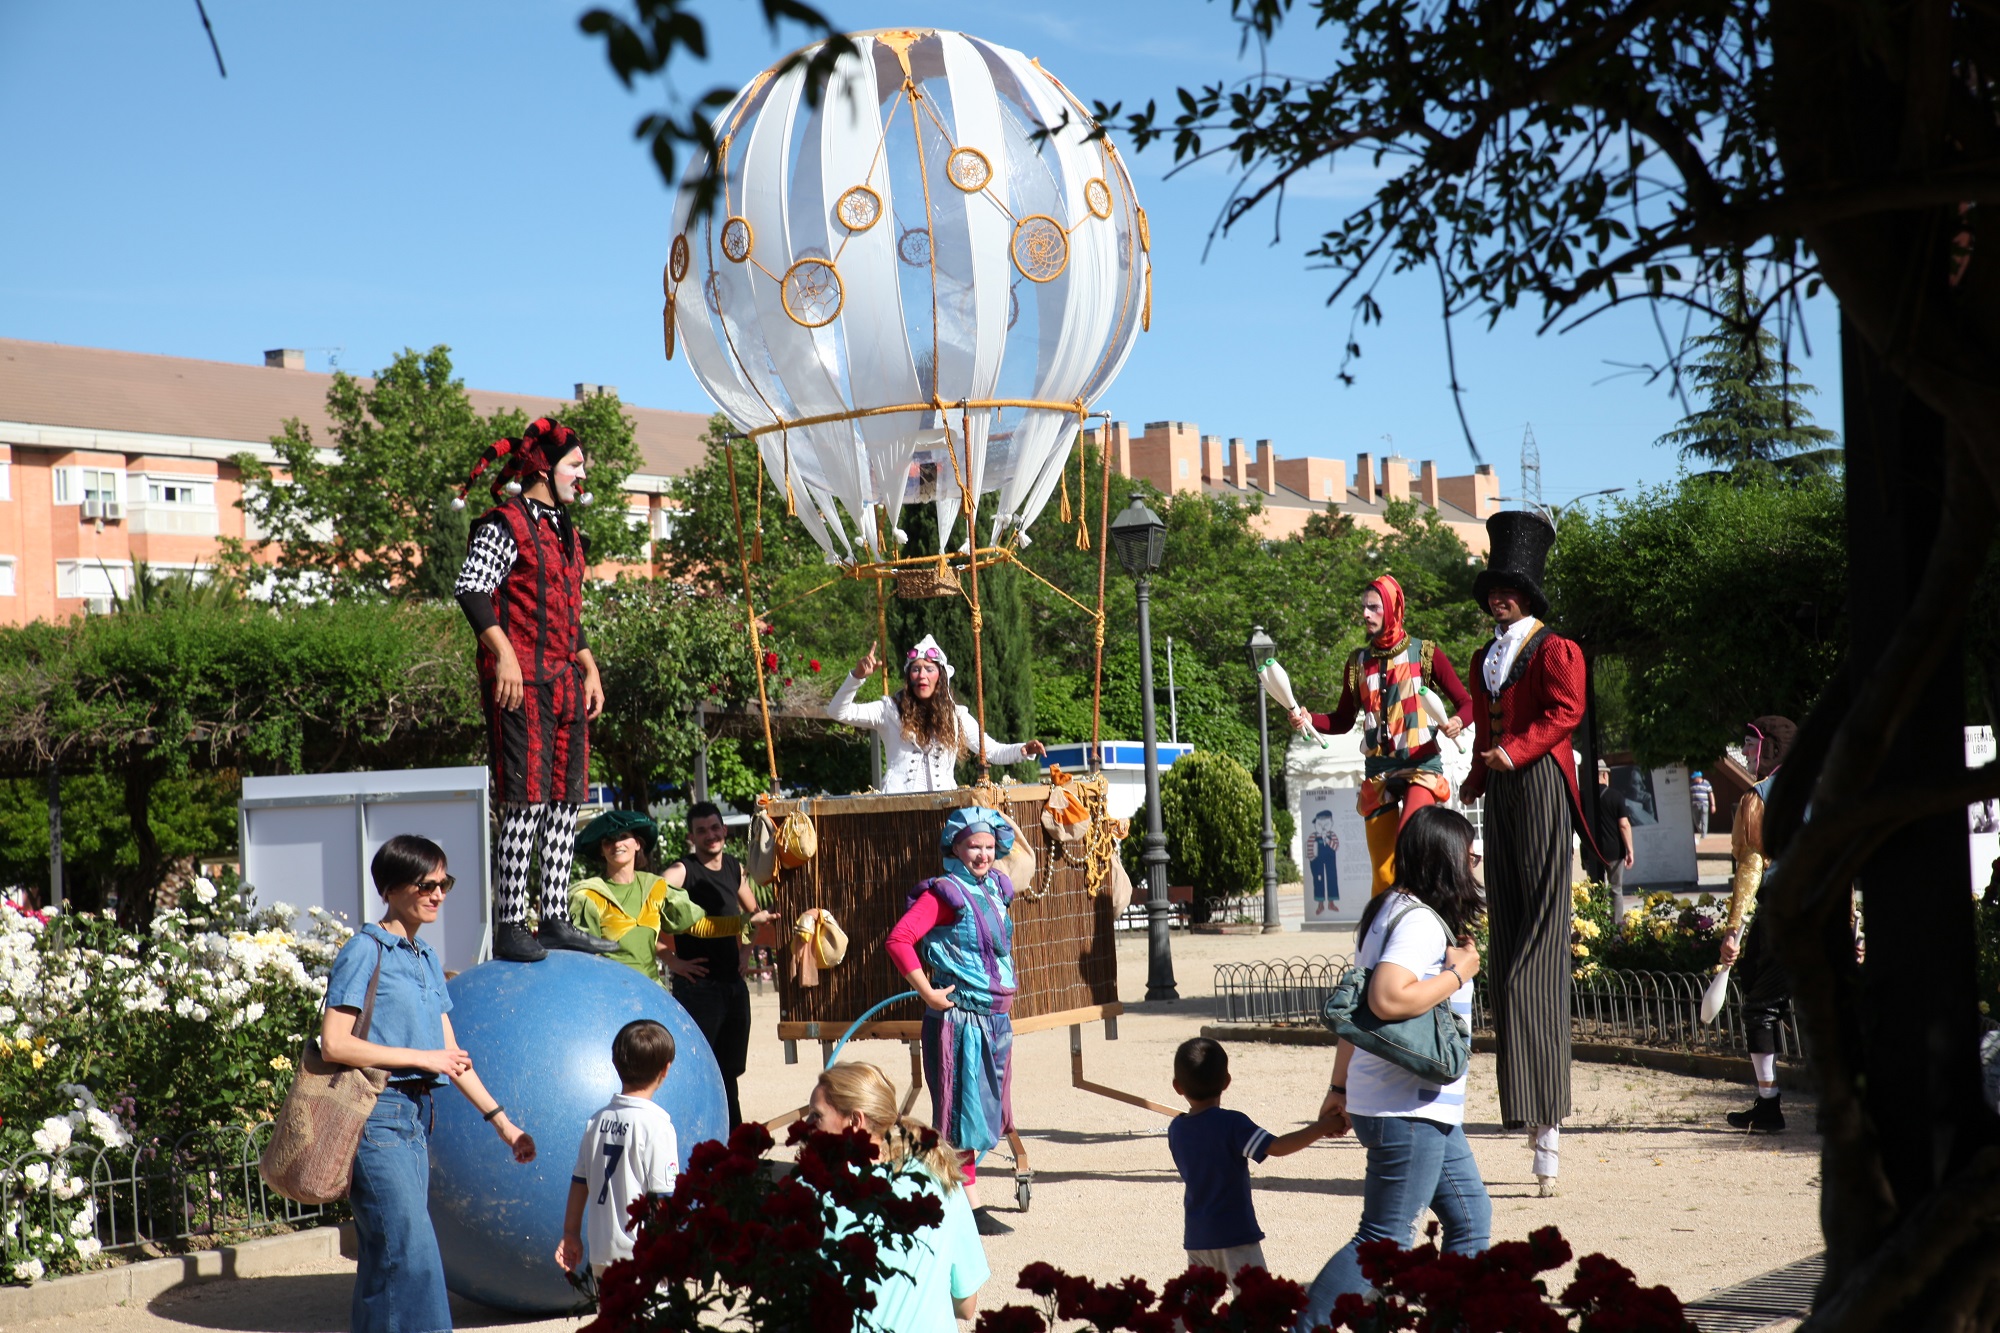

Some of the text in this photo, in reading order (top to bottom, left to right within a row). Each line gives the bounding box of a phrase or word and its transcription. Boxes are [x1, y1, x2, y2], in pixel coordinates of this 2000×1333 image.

[1972, 744, 1988, 754] LIBRO
[600, 1118, 629, 1137] LUCAS
[597, 1142, 625, 1205] 7
